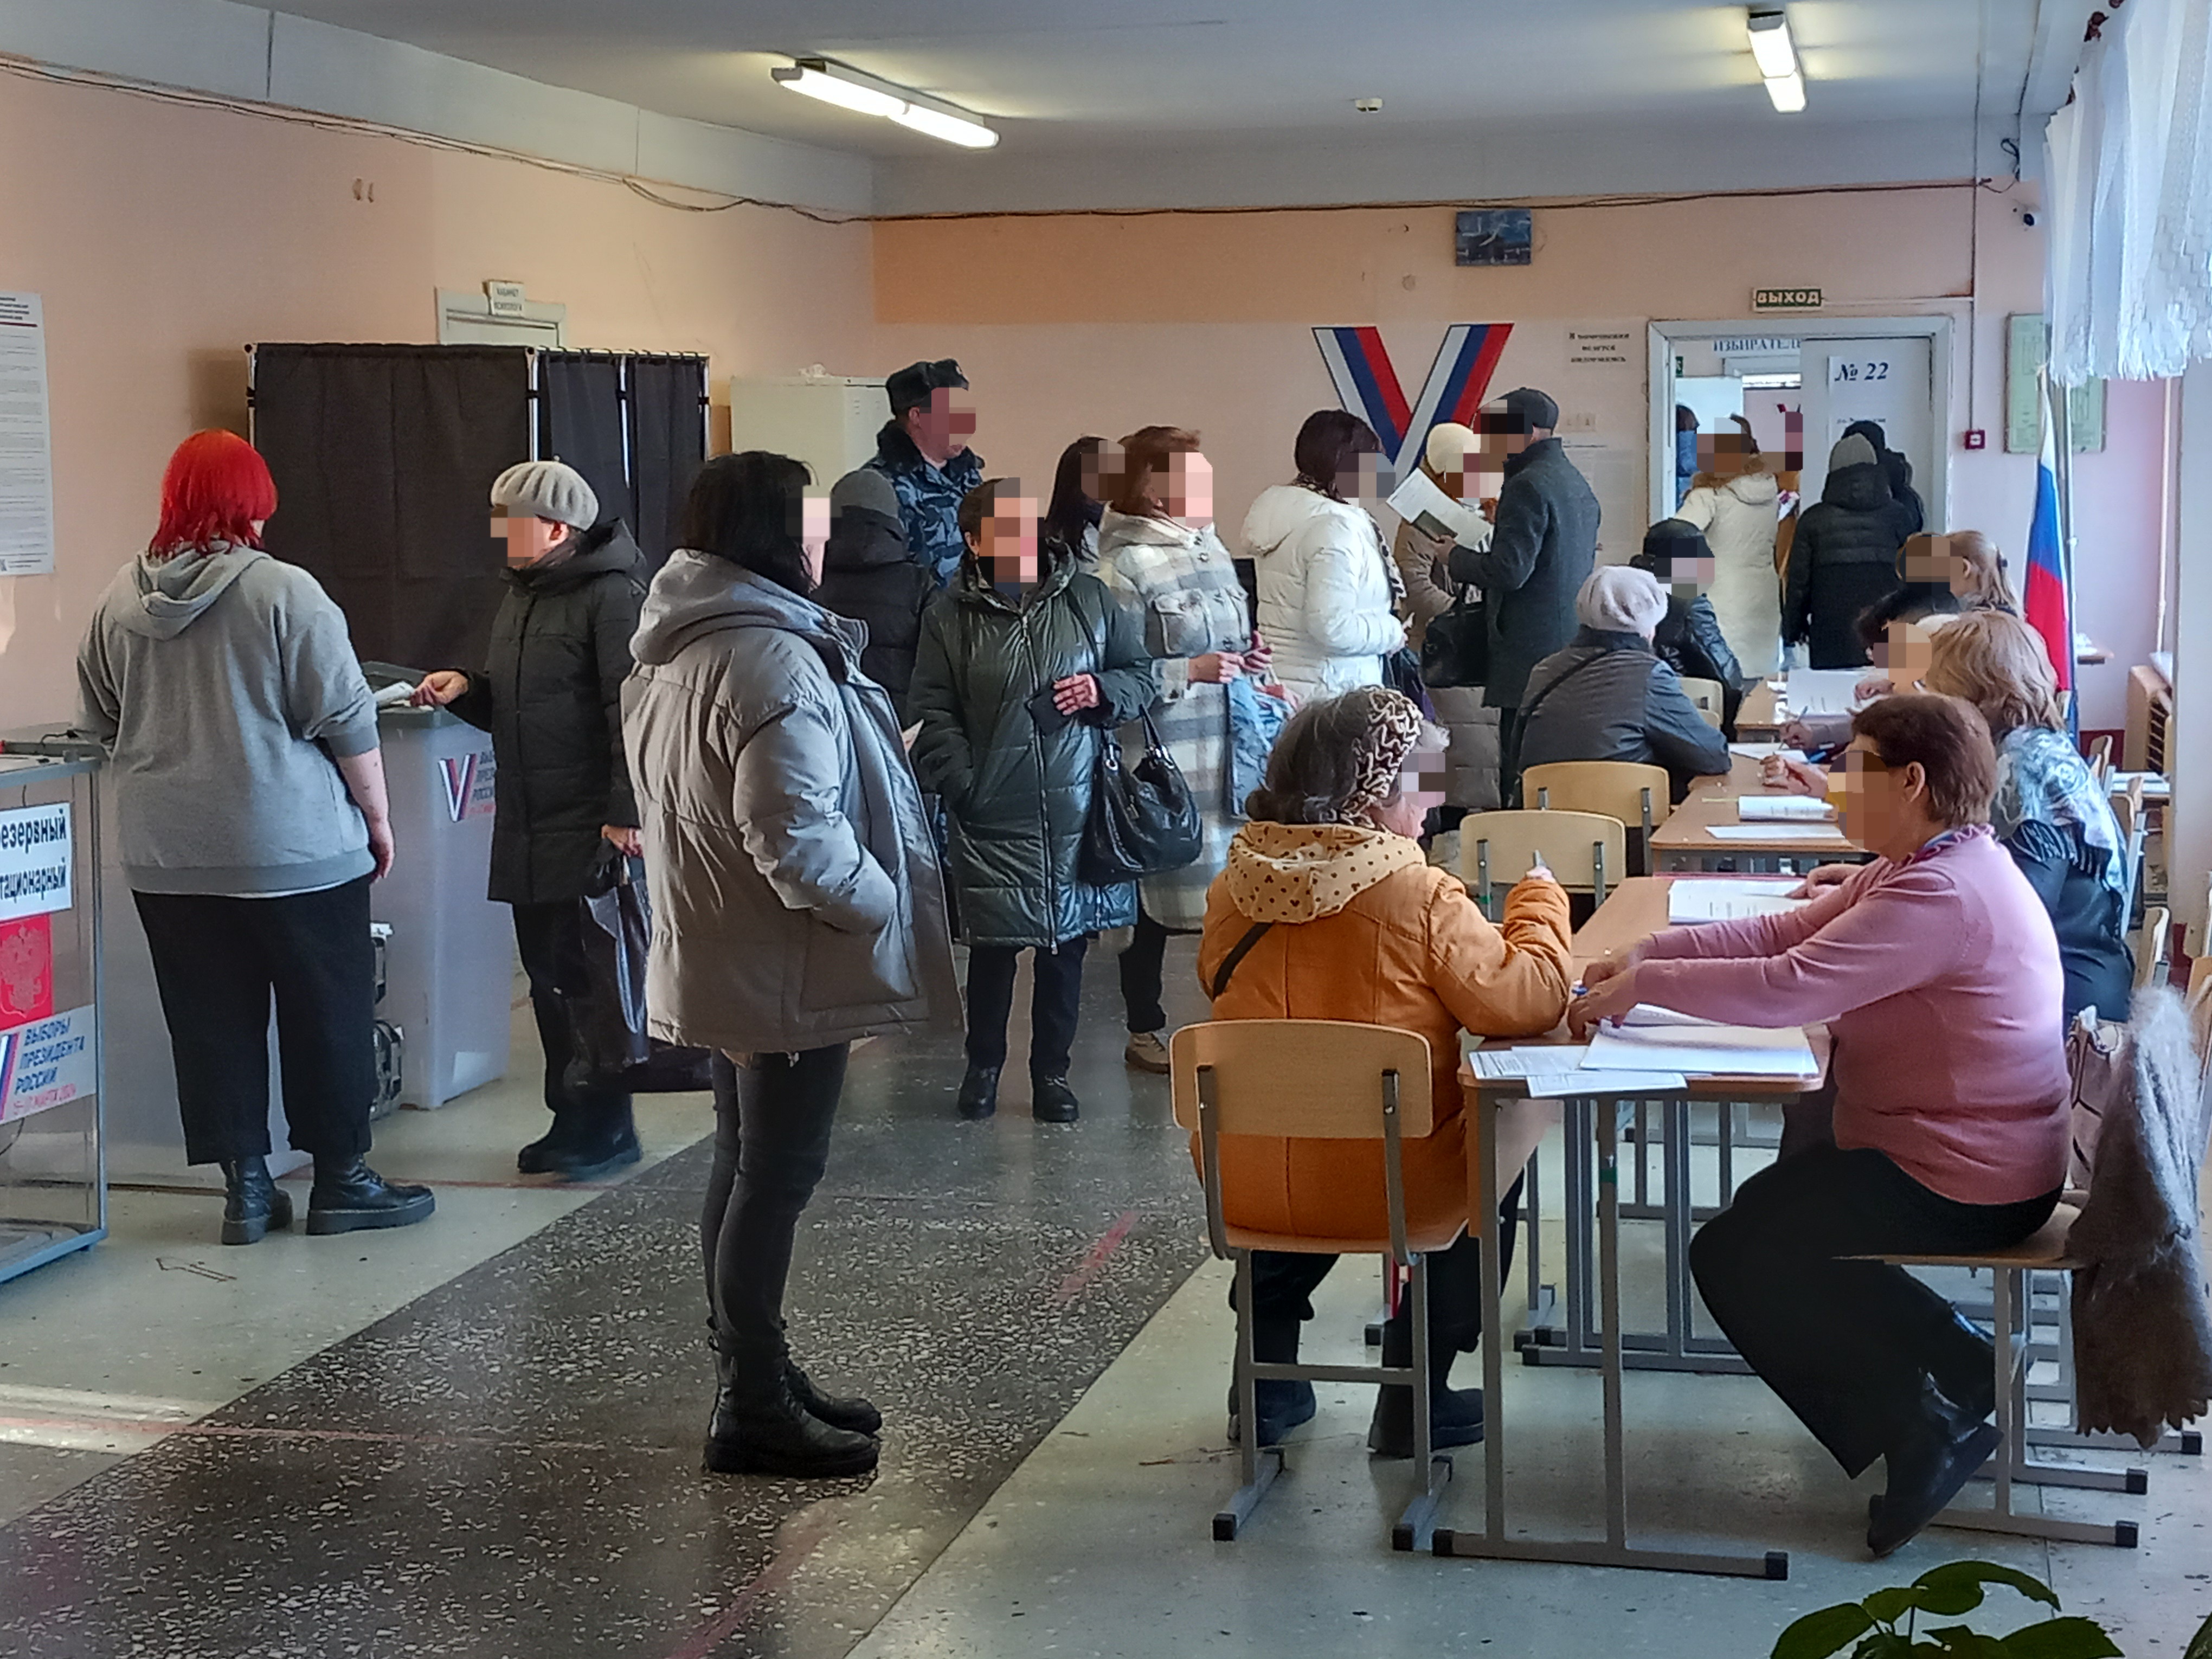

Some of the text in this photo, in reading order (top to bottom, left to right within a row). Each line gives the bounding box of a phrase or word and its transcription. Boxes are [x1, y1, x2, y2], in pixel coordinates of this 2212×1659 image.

[1757, 291, 1820, 305] ВЫХОД
[1834, 362, 1889, 382] № 22
[1, 808, 66, 854] езервный
[0, 857, 66, 903] тационарный
